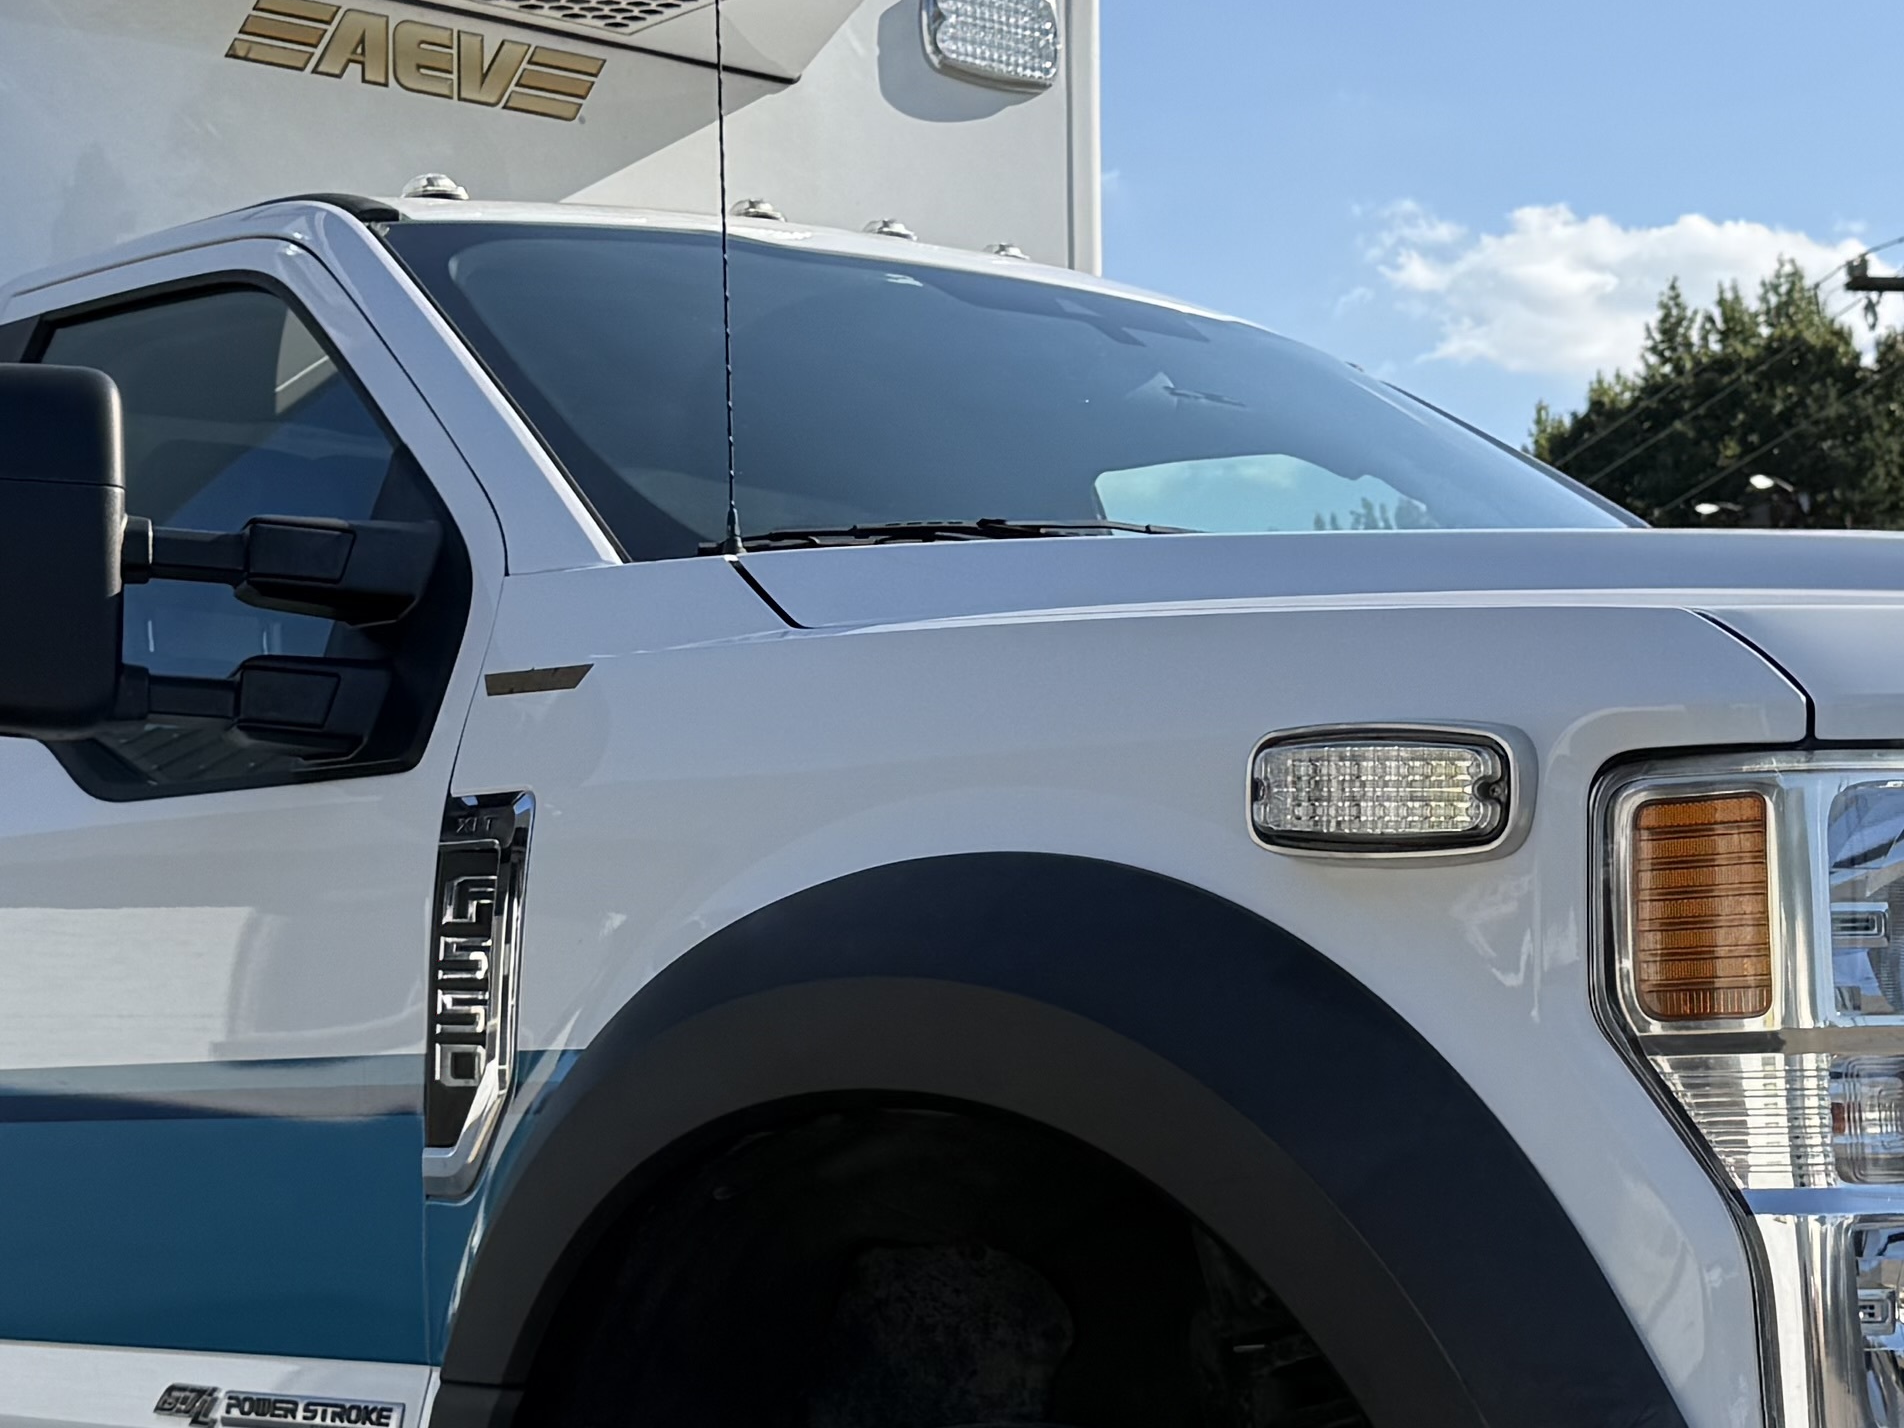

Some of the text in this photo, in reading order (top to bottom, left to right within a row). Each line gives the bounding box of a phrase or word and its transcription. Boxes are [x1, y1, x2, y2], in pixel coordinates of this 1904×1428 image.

[434, 875, 498, 1088] F550
[225, 1395, 299, 1421] POWER
[302, 1400, 393, 1428] STROKE
